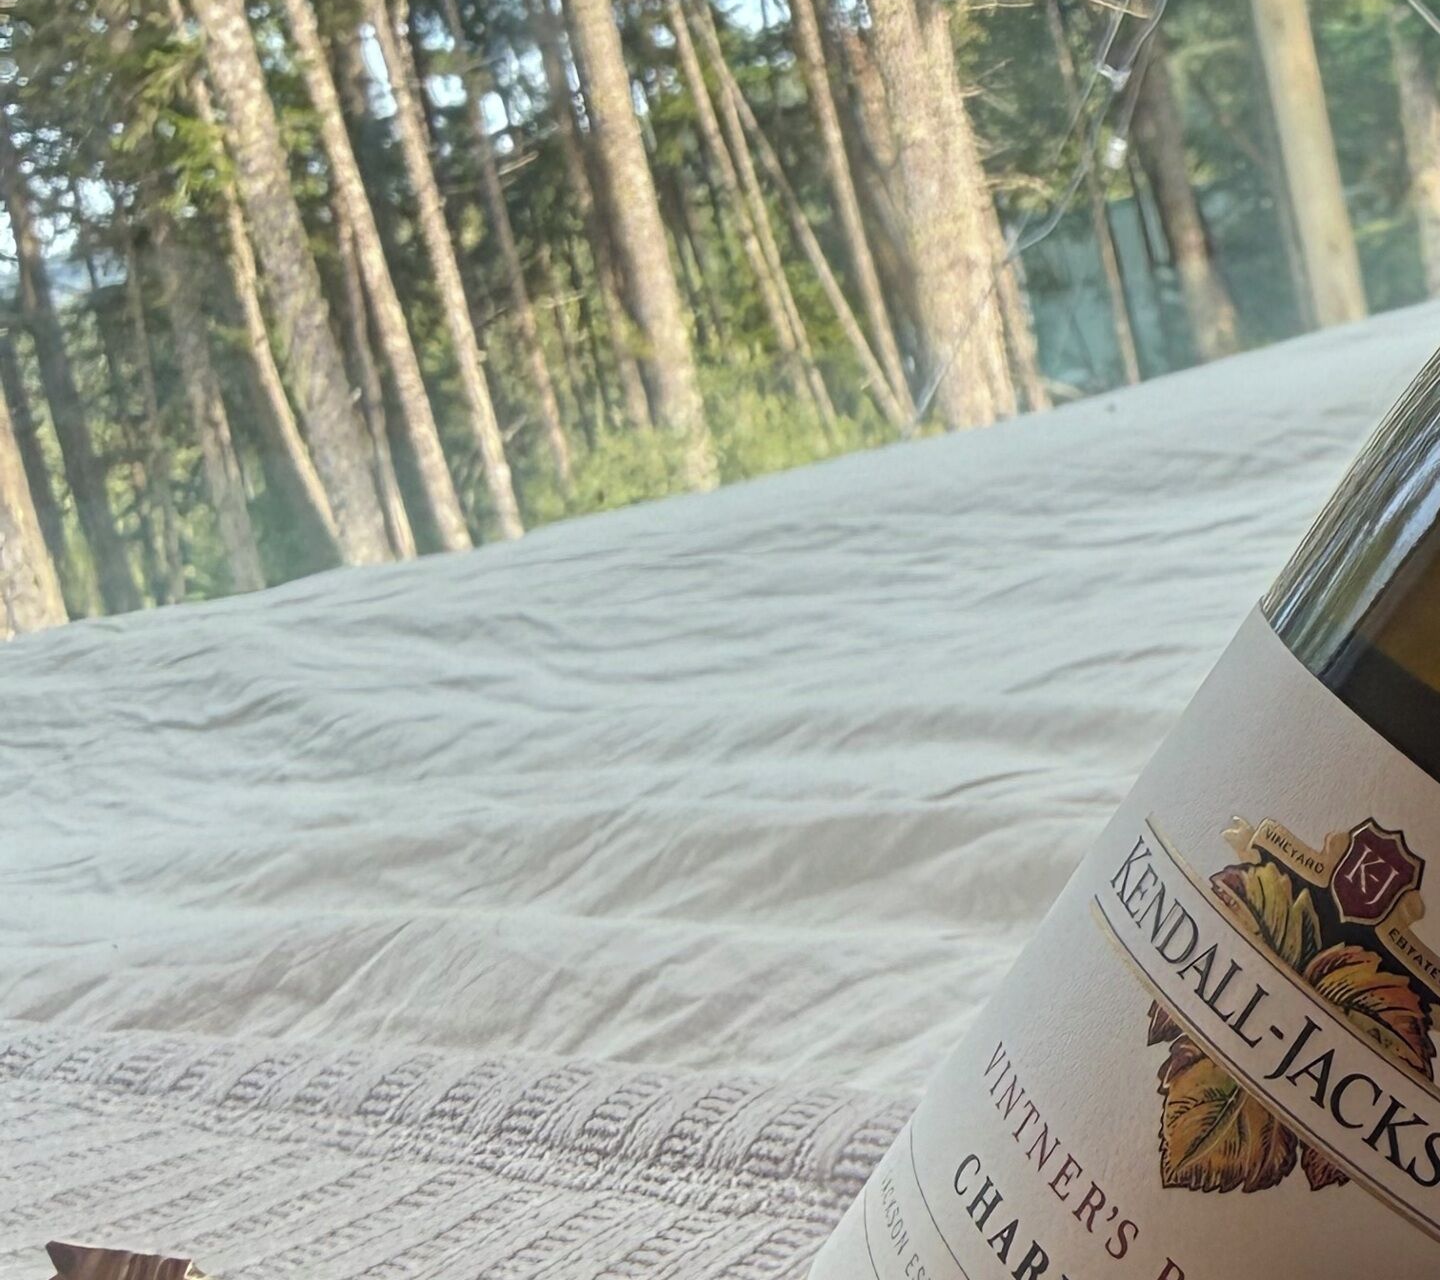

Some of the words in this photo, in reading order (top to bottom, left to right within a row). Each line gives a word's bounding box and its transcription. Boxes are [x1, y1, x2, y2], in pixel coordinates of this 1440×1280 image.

[1265, 827, 1324, 874] VINEYARD
[1344, 843, 1400, 906] K-J
[983, 1041, 1140, 1260] VINTNER'S
